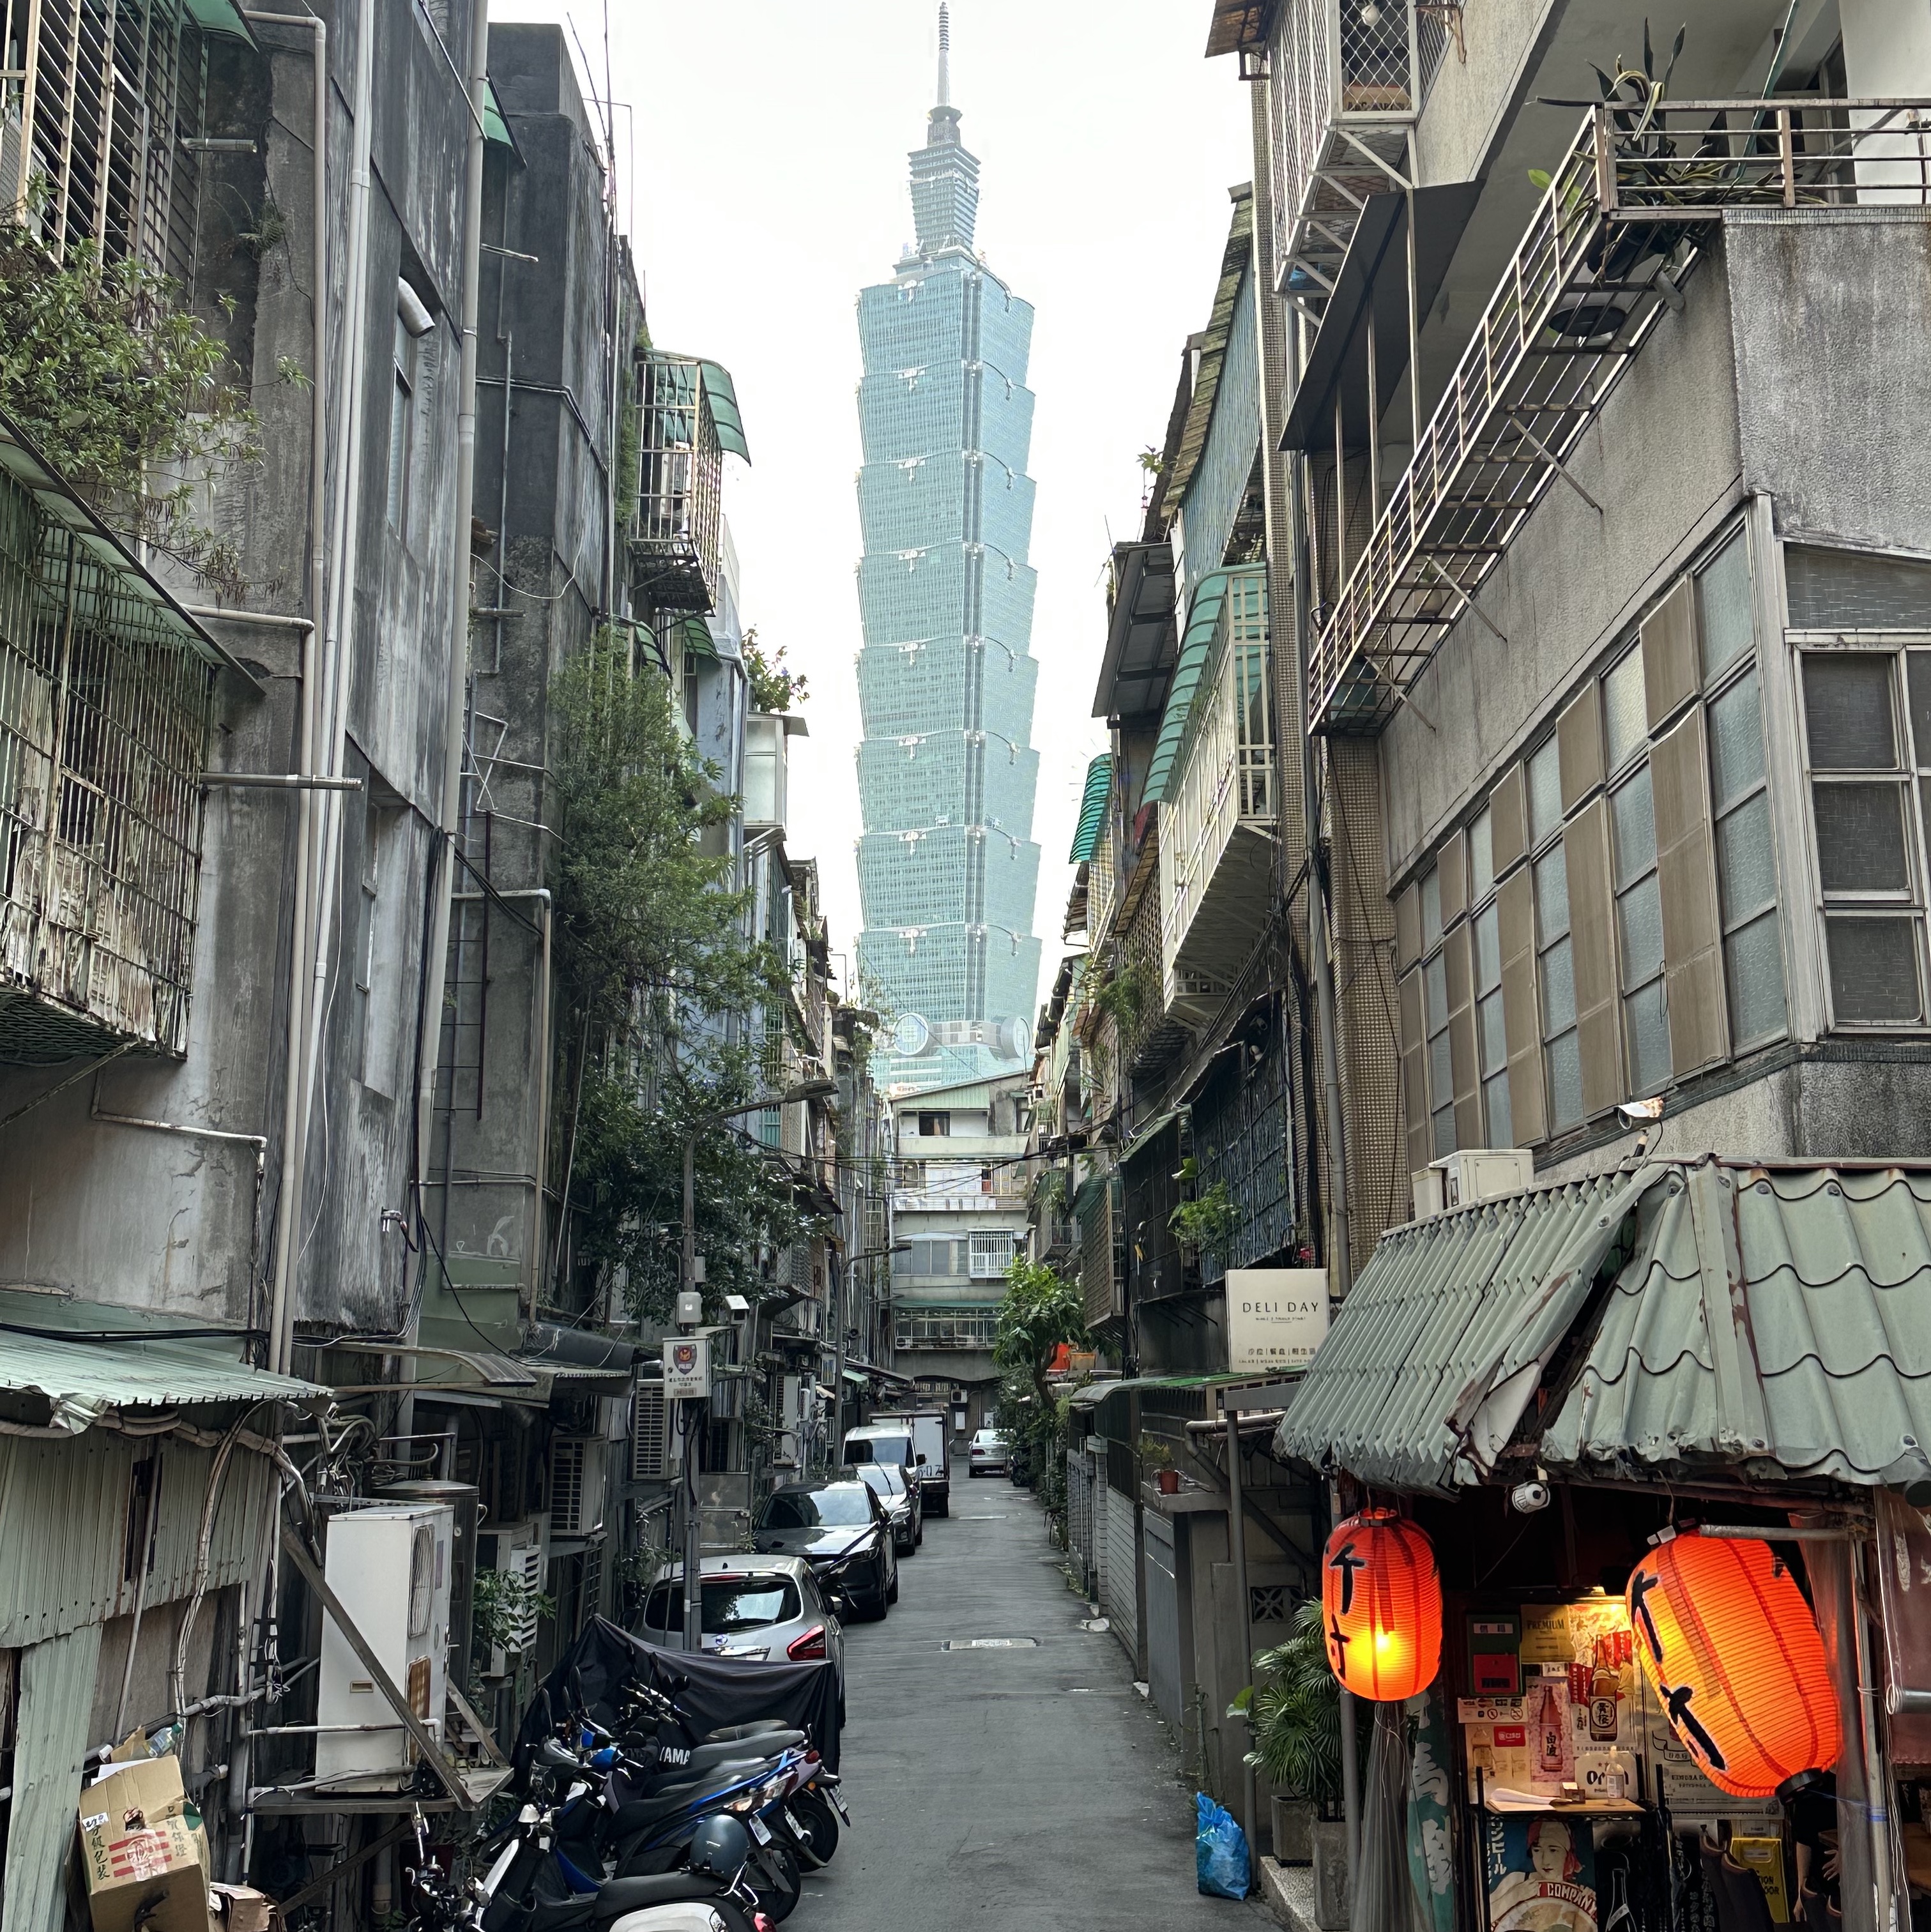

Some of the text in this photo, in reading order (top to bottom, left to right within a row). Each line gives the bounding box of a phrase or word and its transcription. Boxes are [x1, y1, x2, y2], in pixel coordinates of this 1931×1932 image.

[1242, 1302, 1318, 1312] DELI DAY
[1527, 1618, 1565, 1630] PREMIUM
